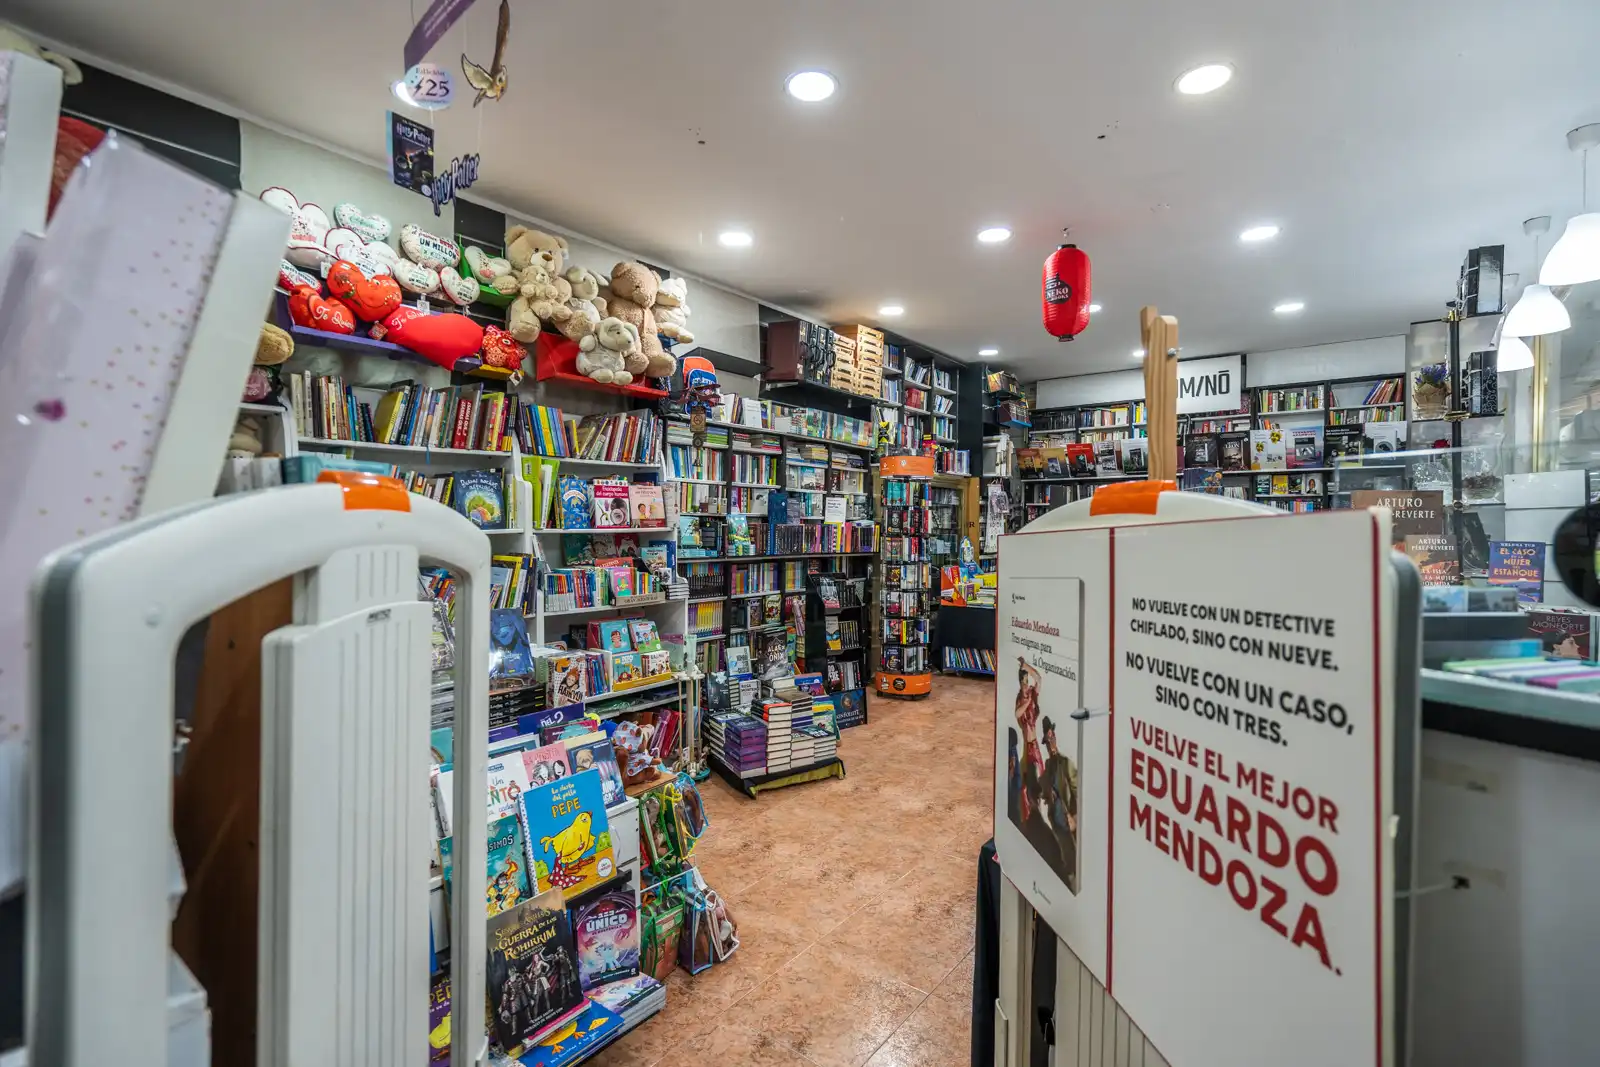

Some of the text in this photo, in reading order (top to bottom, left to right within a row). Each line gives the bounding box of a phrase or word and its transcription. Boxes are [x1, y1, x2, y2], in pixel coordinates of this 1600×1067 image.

[420, 238, 431, 247] UN
[1176, 370, 1230, 399] M/NŌ
[1376, 498, 1423, 508] ARTURO
[1392, 510, 1435, 519] -REVERTE
[1503, 558, 1531, 566] MUJER
[1512, 548, 1536, 556] CASO
[1493, 567, 1540, 577] ESTANQUE
[1011, 616, 1060, 637] Eduardo Mendoza
[1132, 598, 1335, 638] NO VUELVE CON UN DETECTIVE
[1532, 621, 1585, 631] MONFORTE
[1546, 615, 1571, 623] REYES
[1130, 619, 1339, 672] CHIFLADO, SINO CON NUEVE.
[1038, 656, 1076, 681] Organización
[1126, 651, 1354, 735] NO VUELVE CON UN CASO,
[1156, 685, 1288, 747] SINO CON TRES.
[1130, 717, 1338, 835] VUELVE EL MEJOR
[552, 797, 581, 818] PEPE
[1131, 748, 1338, 896] EDUARDO
[487, 834, 514, 853] SIMOS
[1130, 794, 1342, 977] MENDOZA.
[586, 913, 628, 933] ÚNICO
